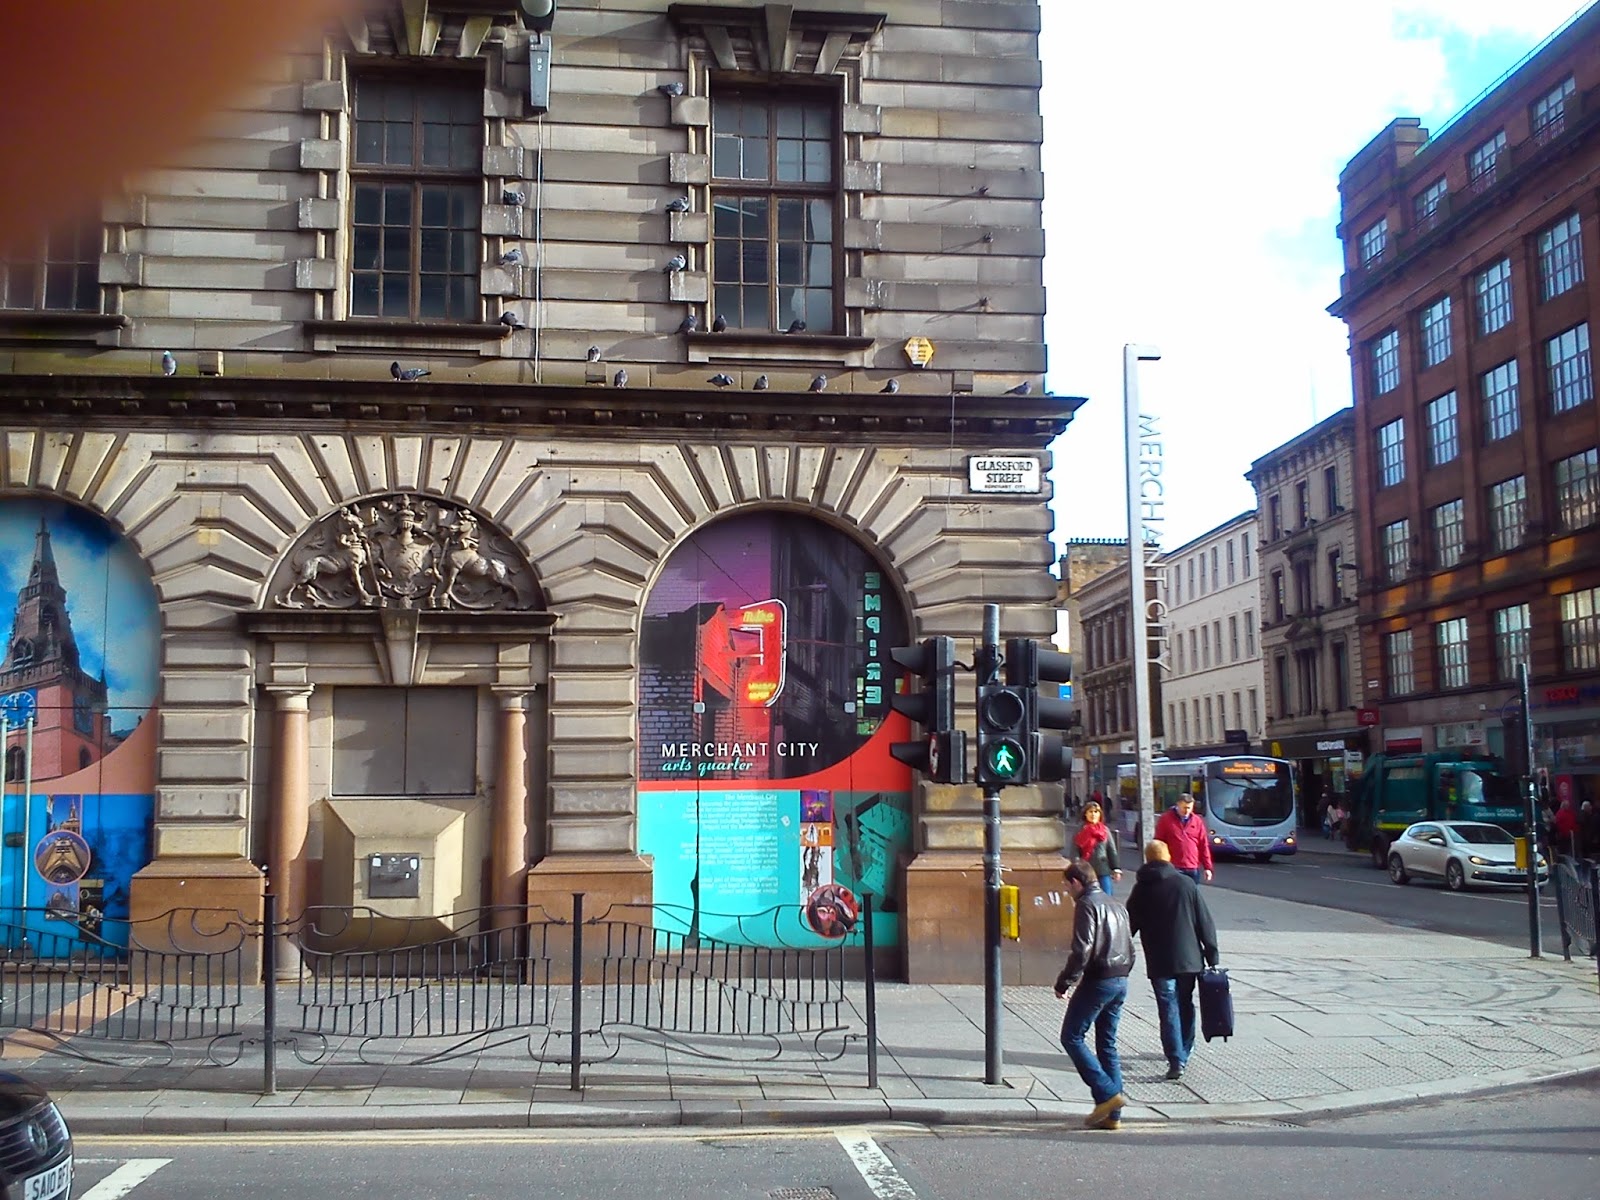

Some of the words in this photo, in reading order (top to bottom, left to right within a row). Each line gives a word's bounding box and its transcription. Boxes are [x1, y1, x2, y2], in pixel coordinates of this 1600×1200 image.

[976, 461, 1033, 471] GLASSFORD
[986, 473, 1023, 483] STREET
[1138, 414, 1167, 589] MERCHANT
[1145, 599, 1171, 673] CITY
[661, 742, 768, 757] MERCHANT
[777, 742, 819, 757] CITY
[662, 757, 692, 771] arts
[698, 757, 753, 776] quarter
